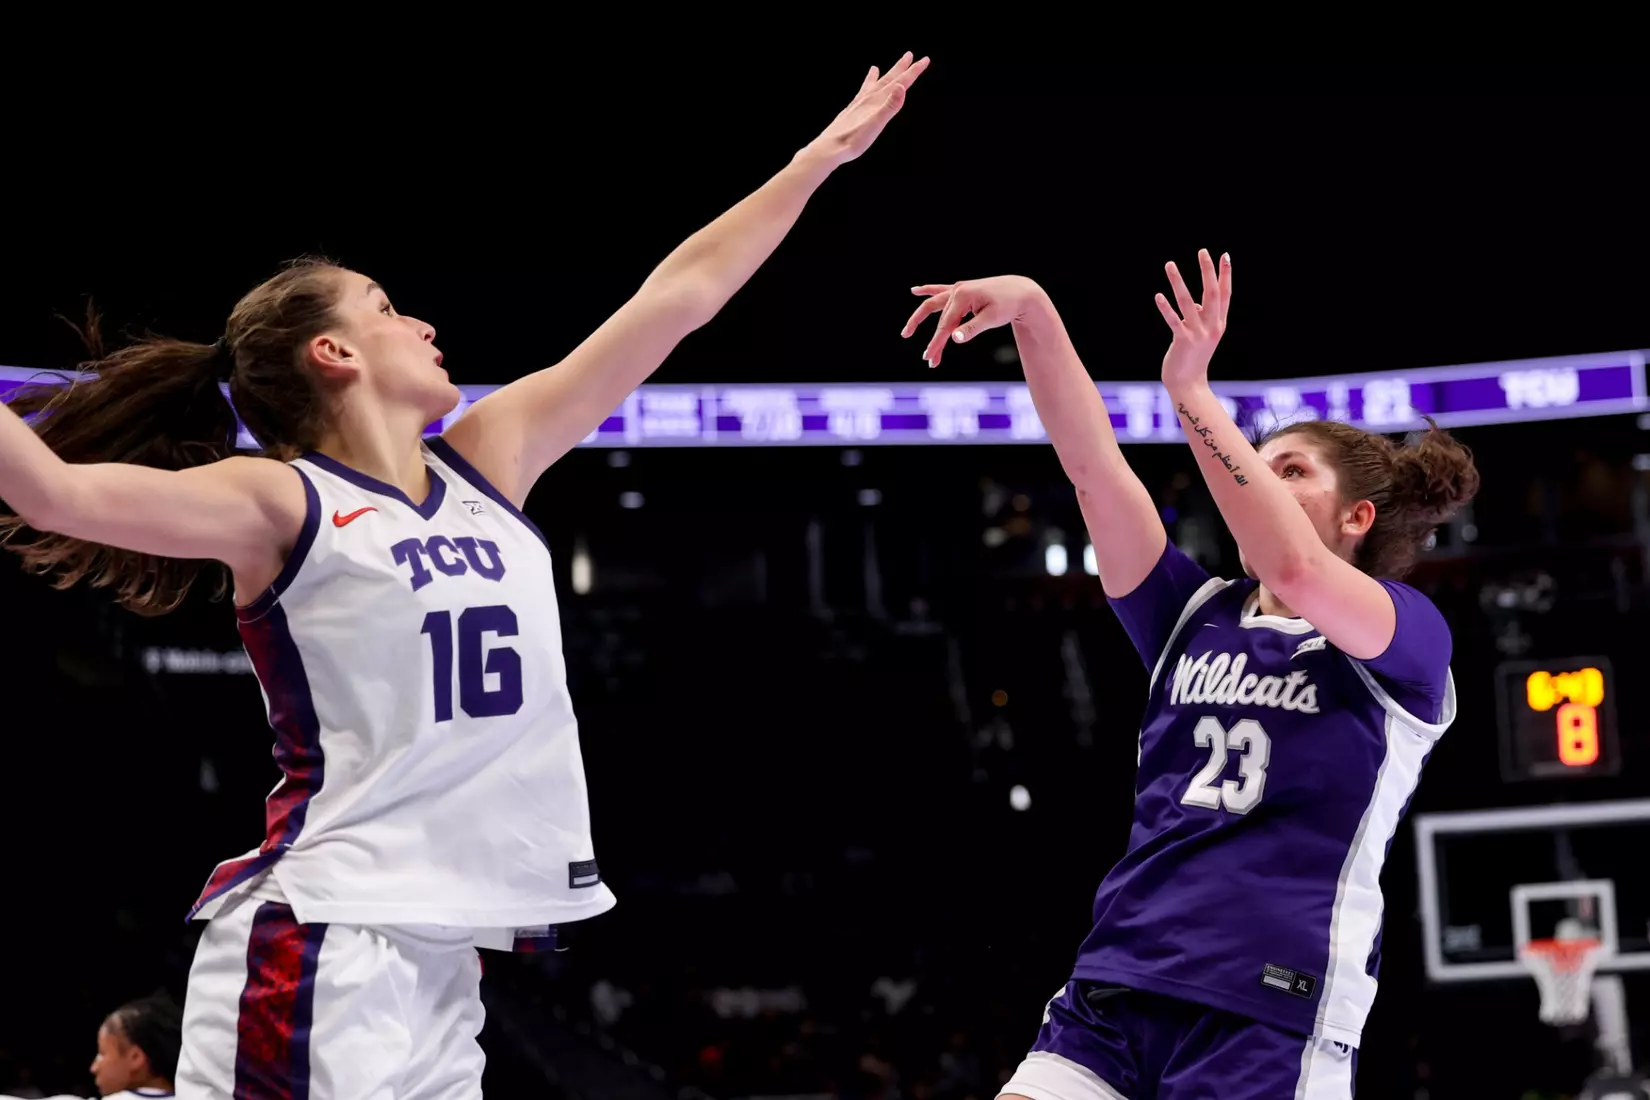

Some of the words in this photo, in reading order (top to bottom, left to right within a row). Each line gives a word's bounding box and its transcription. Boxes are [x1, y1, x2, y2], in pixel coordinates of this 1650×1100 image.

[390, 534, 507, 592] TCU
[420, 604, 524, 723] 16
[1170, 650, 1320, 714] Wildcats
[1180, 715, 1272, 815] 23
[1557, 702, 1599, 766] 8
[1297, 979, 1308, 992] XL
